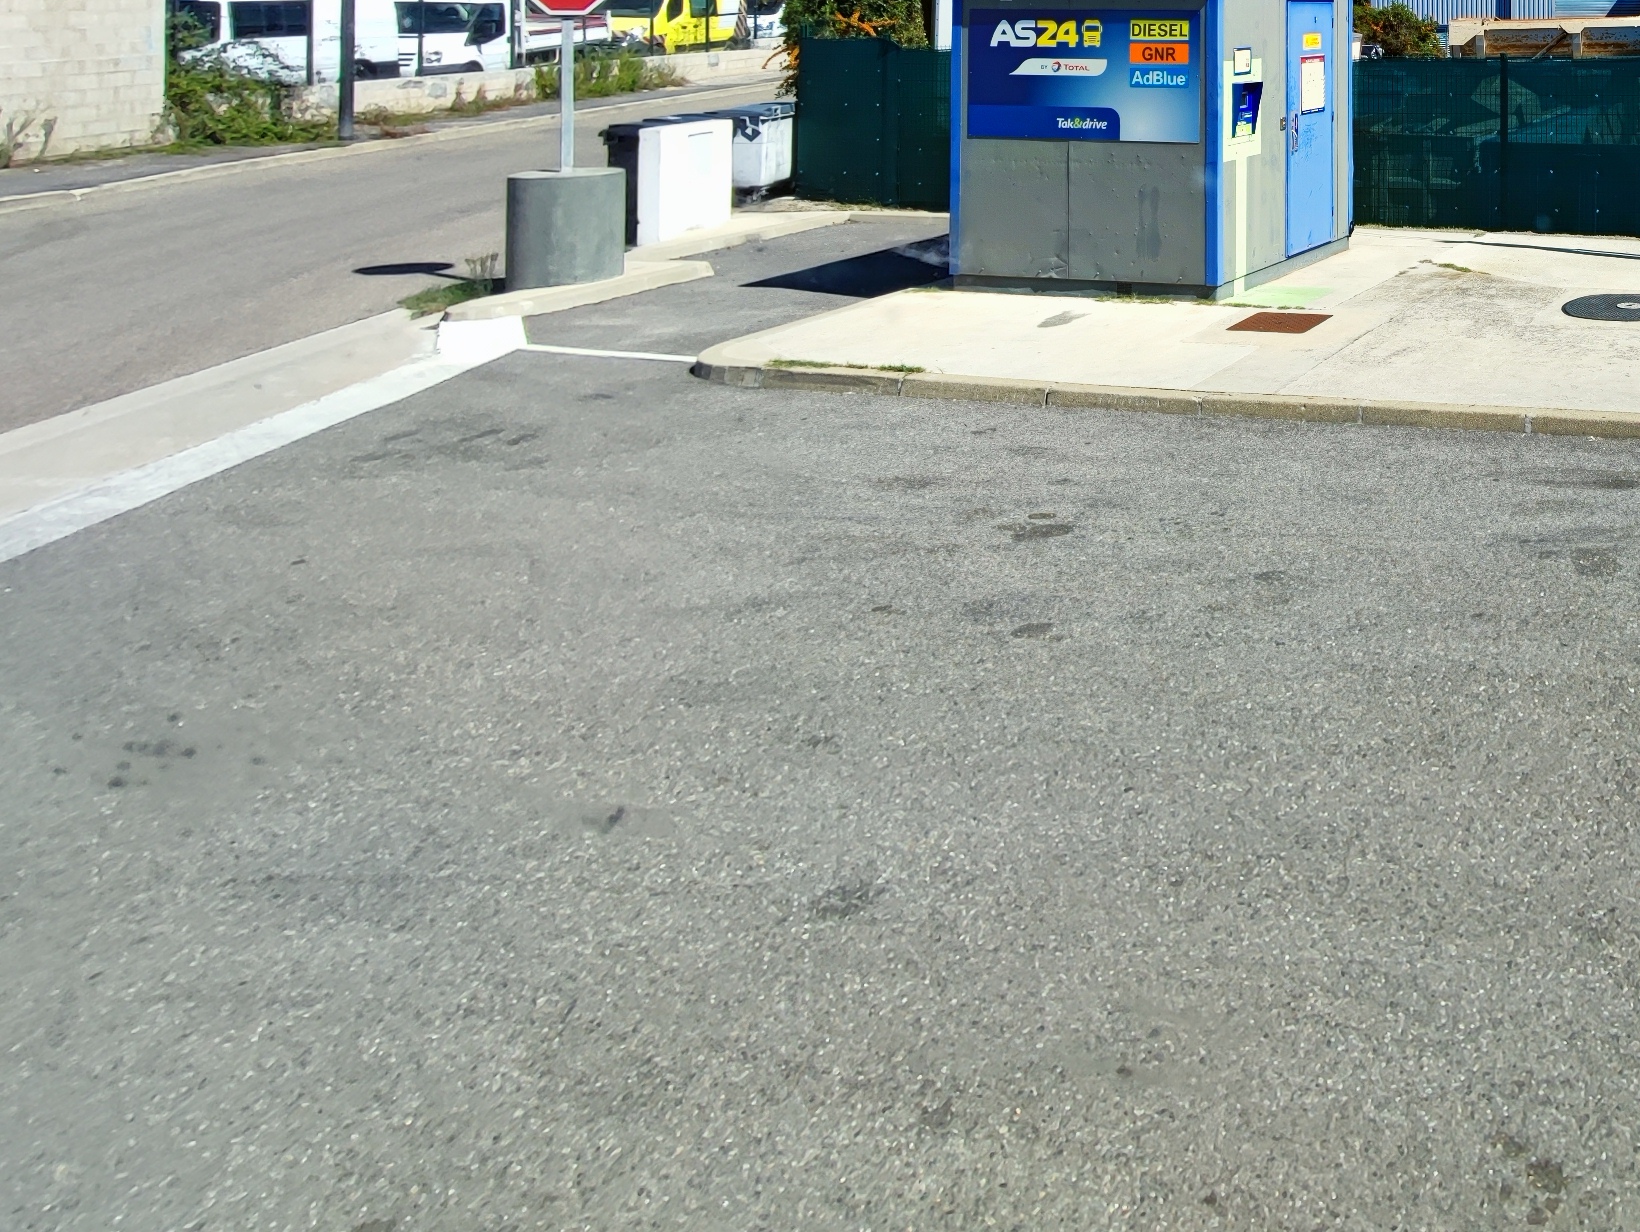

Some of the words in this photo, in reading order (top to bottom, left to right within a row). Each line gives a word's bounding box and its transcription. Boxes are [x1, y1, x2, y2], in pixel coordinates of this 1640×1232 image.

[989, 19, 1079, 48] AS24
[1131, 23, 1188, 37] DIESEL
[1142, 46, 1176, 61] GNR
[1064, 63, 1090, 72] TOTAL
[1131, 70, 1187, 86] AdBlue
